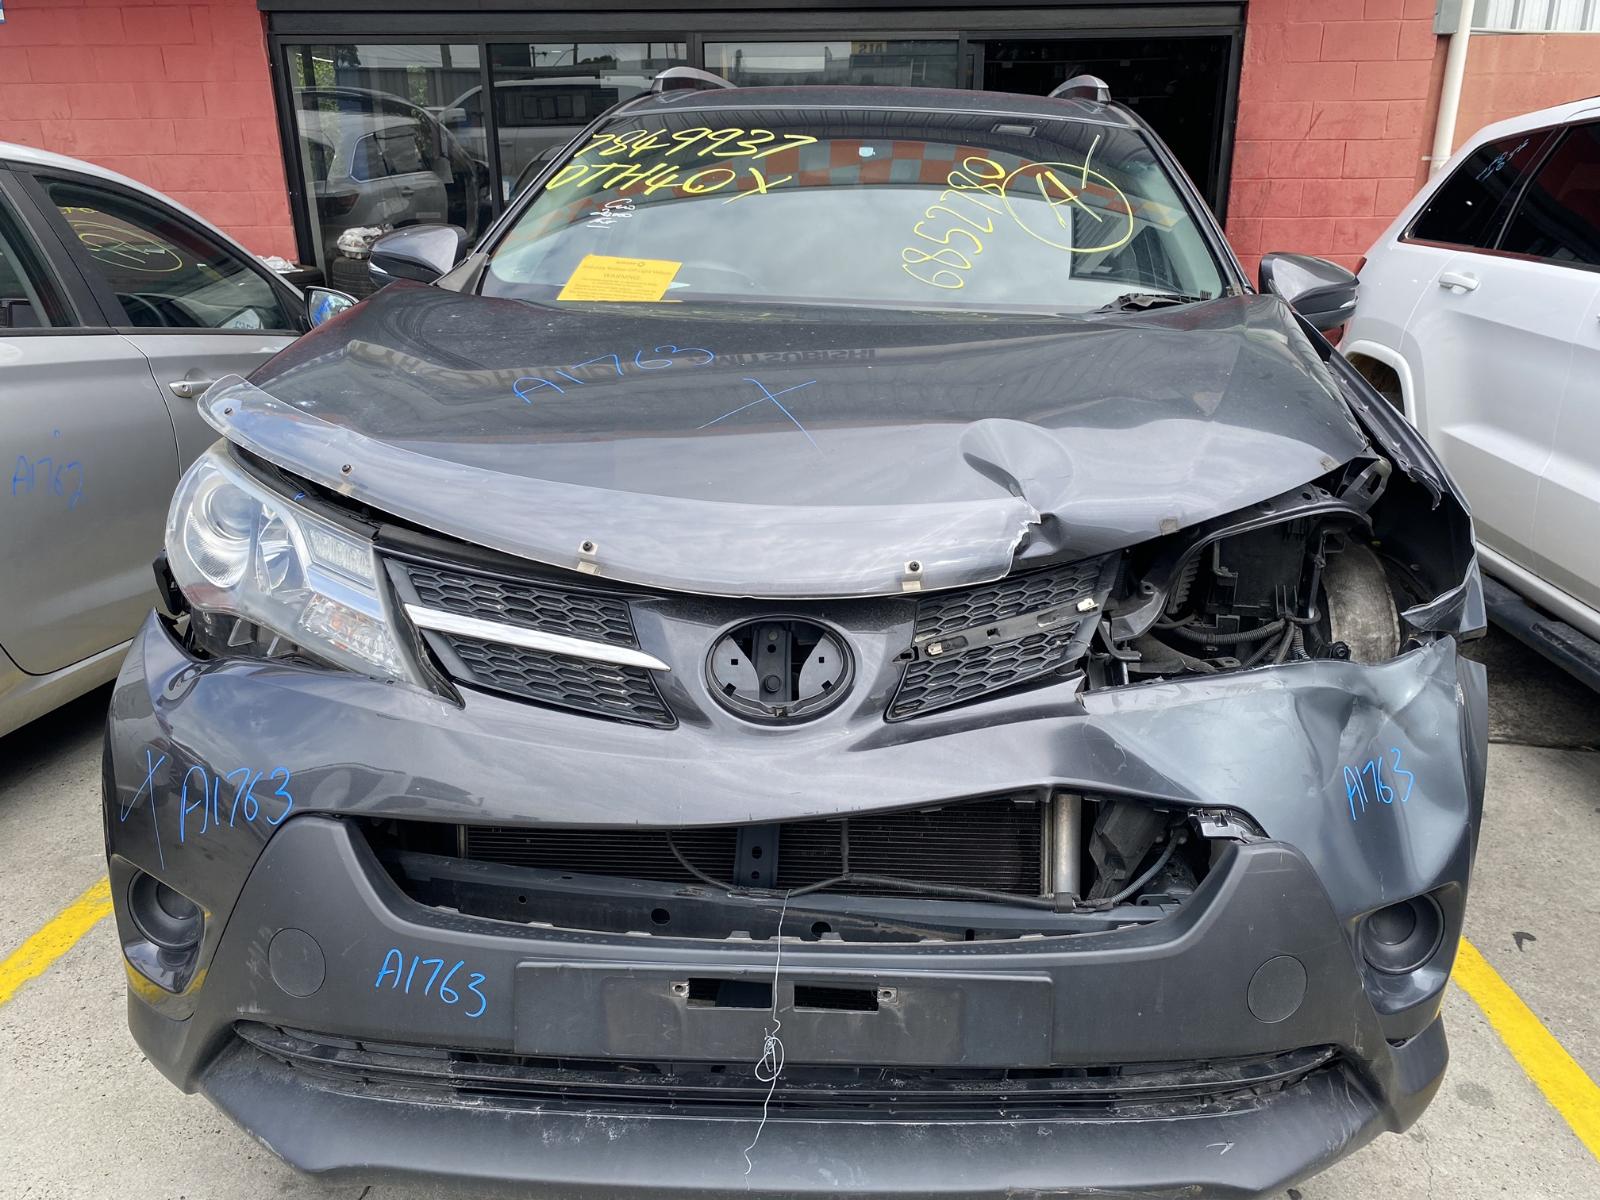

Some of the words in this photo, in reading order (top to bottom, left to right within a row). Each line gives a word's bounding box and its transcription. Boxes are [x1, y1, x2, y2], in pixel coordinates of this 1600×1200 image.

[573, 128, 818, 160] 7849937
[511, 345, 716, 405] A1763
[180, 766, 293, 843] A1763
[1343, 748, 1415, 821] A1763
[375, 948, 487, 1018] A1763
